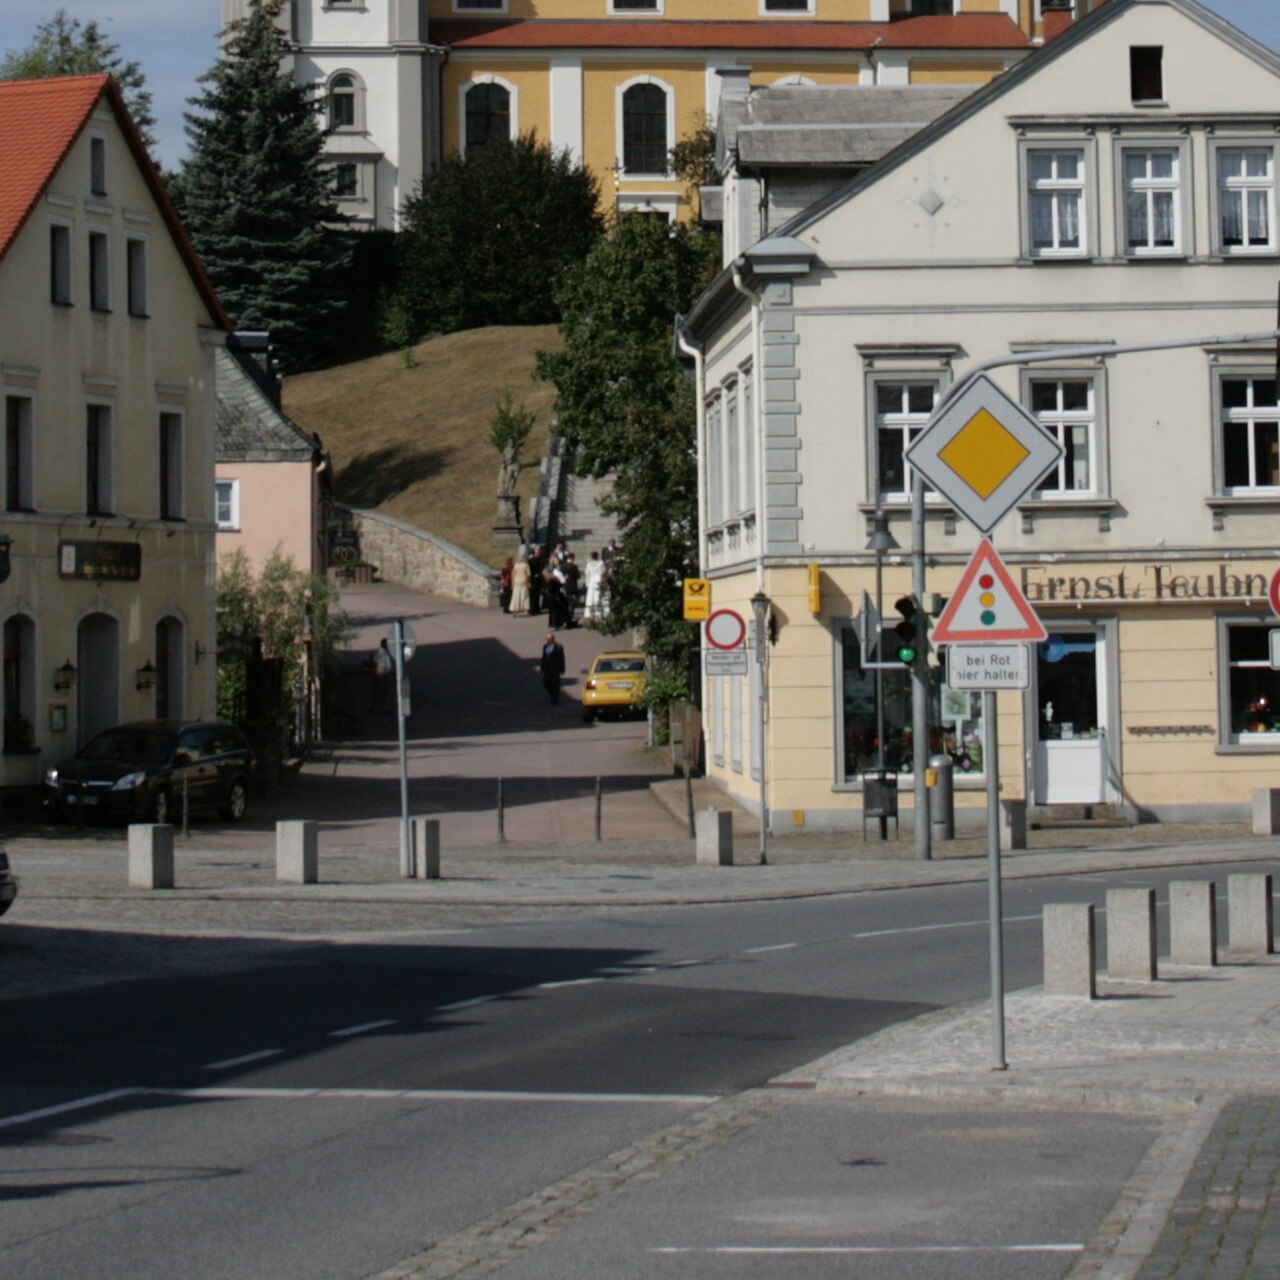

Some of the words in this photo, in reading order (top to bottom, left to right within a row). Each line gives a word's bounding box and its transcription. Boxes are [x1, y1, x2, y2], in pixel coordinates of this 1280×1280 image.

[1020, 564, 1129, 601] Ernst
[966, 654, 985, 666] bei
[990, 654, 1011, 666] Rot
